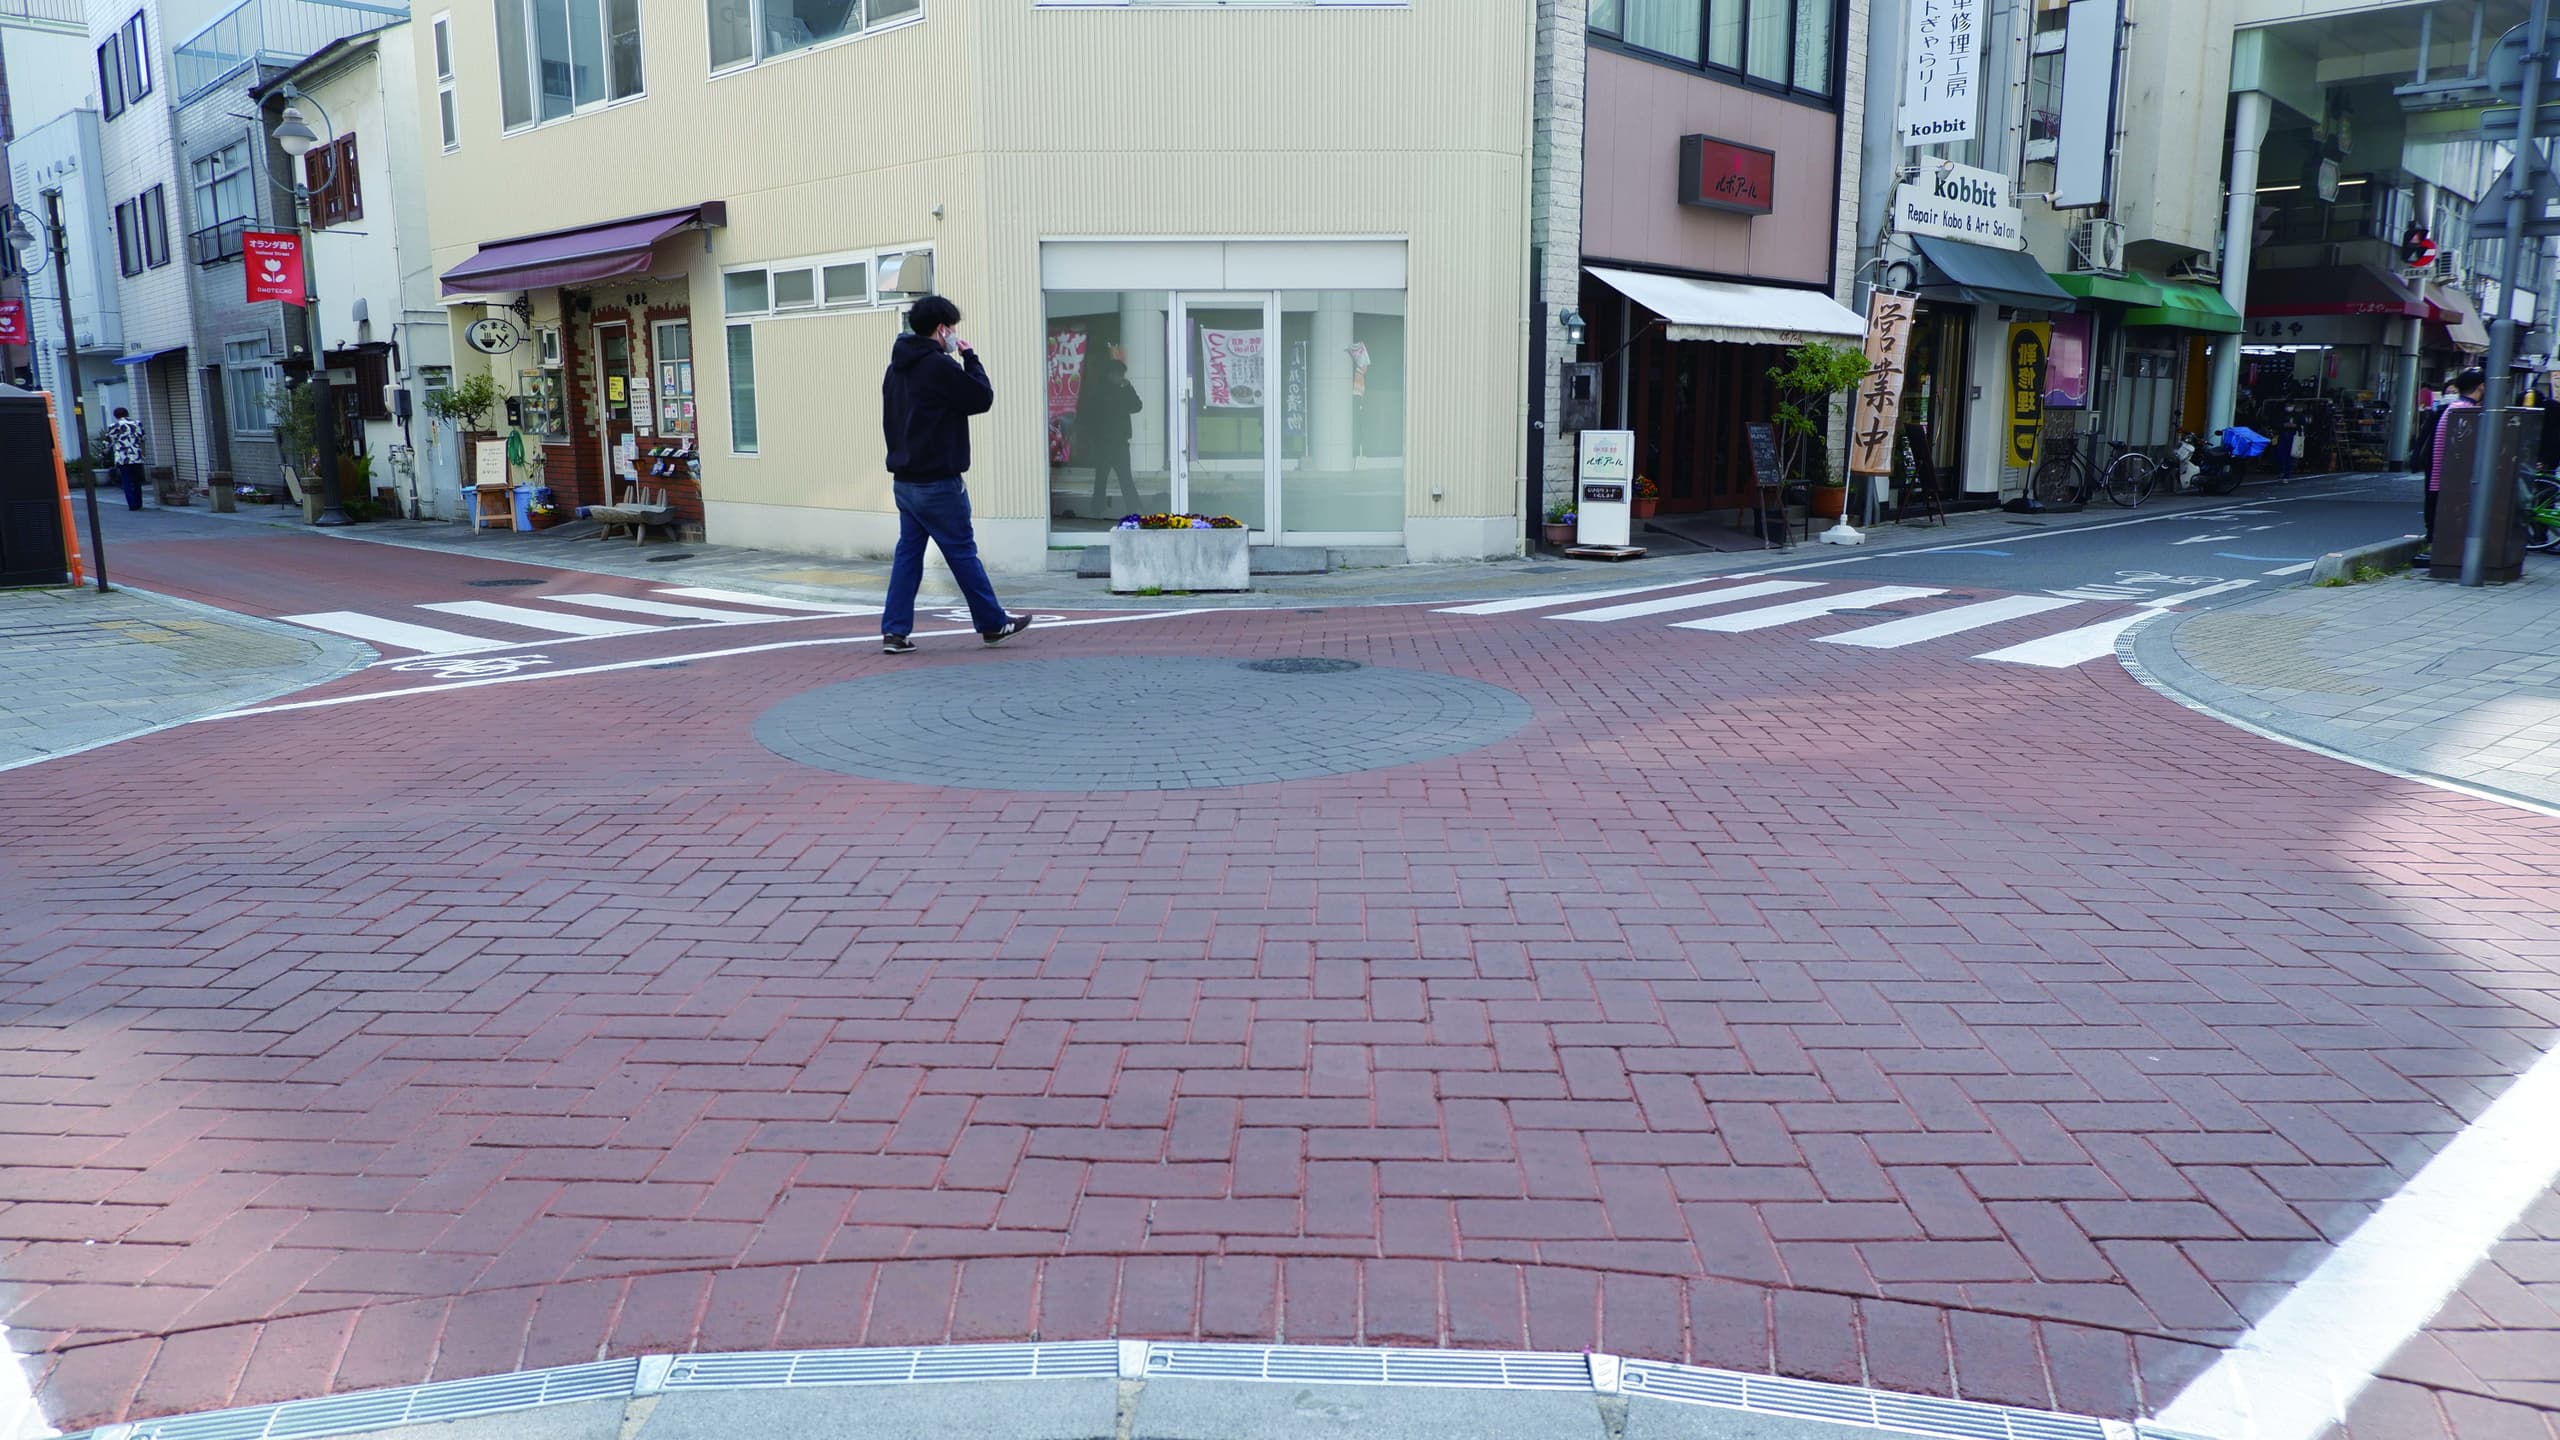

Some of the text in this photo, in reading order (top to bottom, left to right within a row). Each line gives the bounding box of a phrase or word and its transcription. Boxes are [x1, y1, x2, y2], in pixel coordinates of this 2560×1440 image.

[1911, 118, 1967, 137] kobbit
[1934, 171, 1997, 209] kobbit
[1907, 203, 2015, 239] Repair Kobo & Art Salon
[479, 321, 508, 333] やまと
[2255, 321, 2303, 337] しまや
[1855, 303, 1907, 466] 営業中
